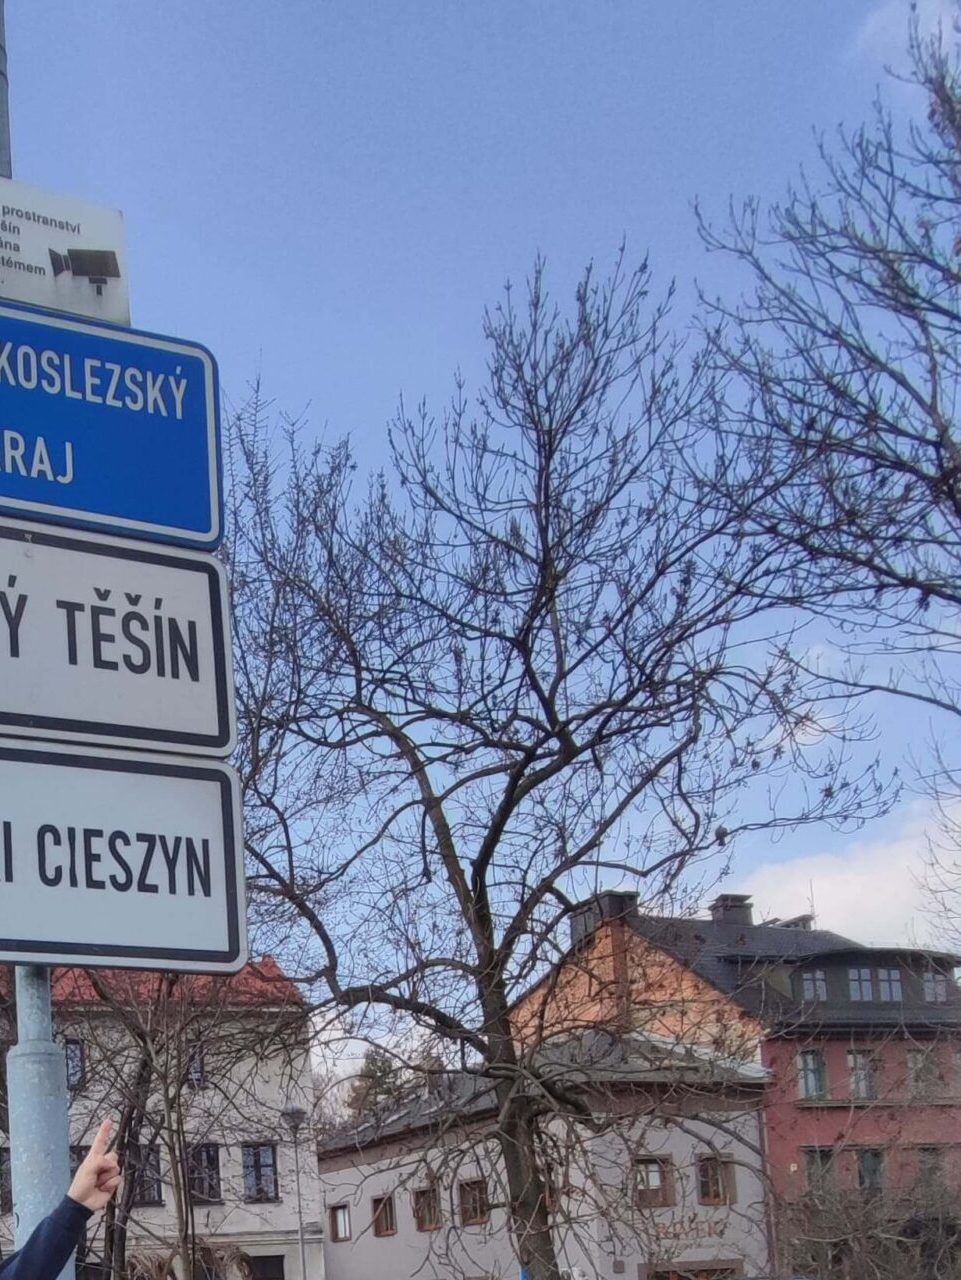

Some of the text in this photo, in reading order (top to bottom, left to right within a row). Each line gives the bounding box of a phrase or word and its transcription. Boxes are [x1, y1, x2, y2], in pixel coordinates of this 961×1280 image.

[1, 204, 81, 235] prostranství
[55, 586, 200, 683] TĚŠÍN
[36, 823, 212, 898] CIESZYN
